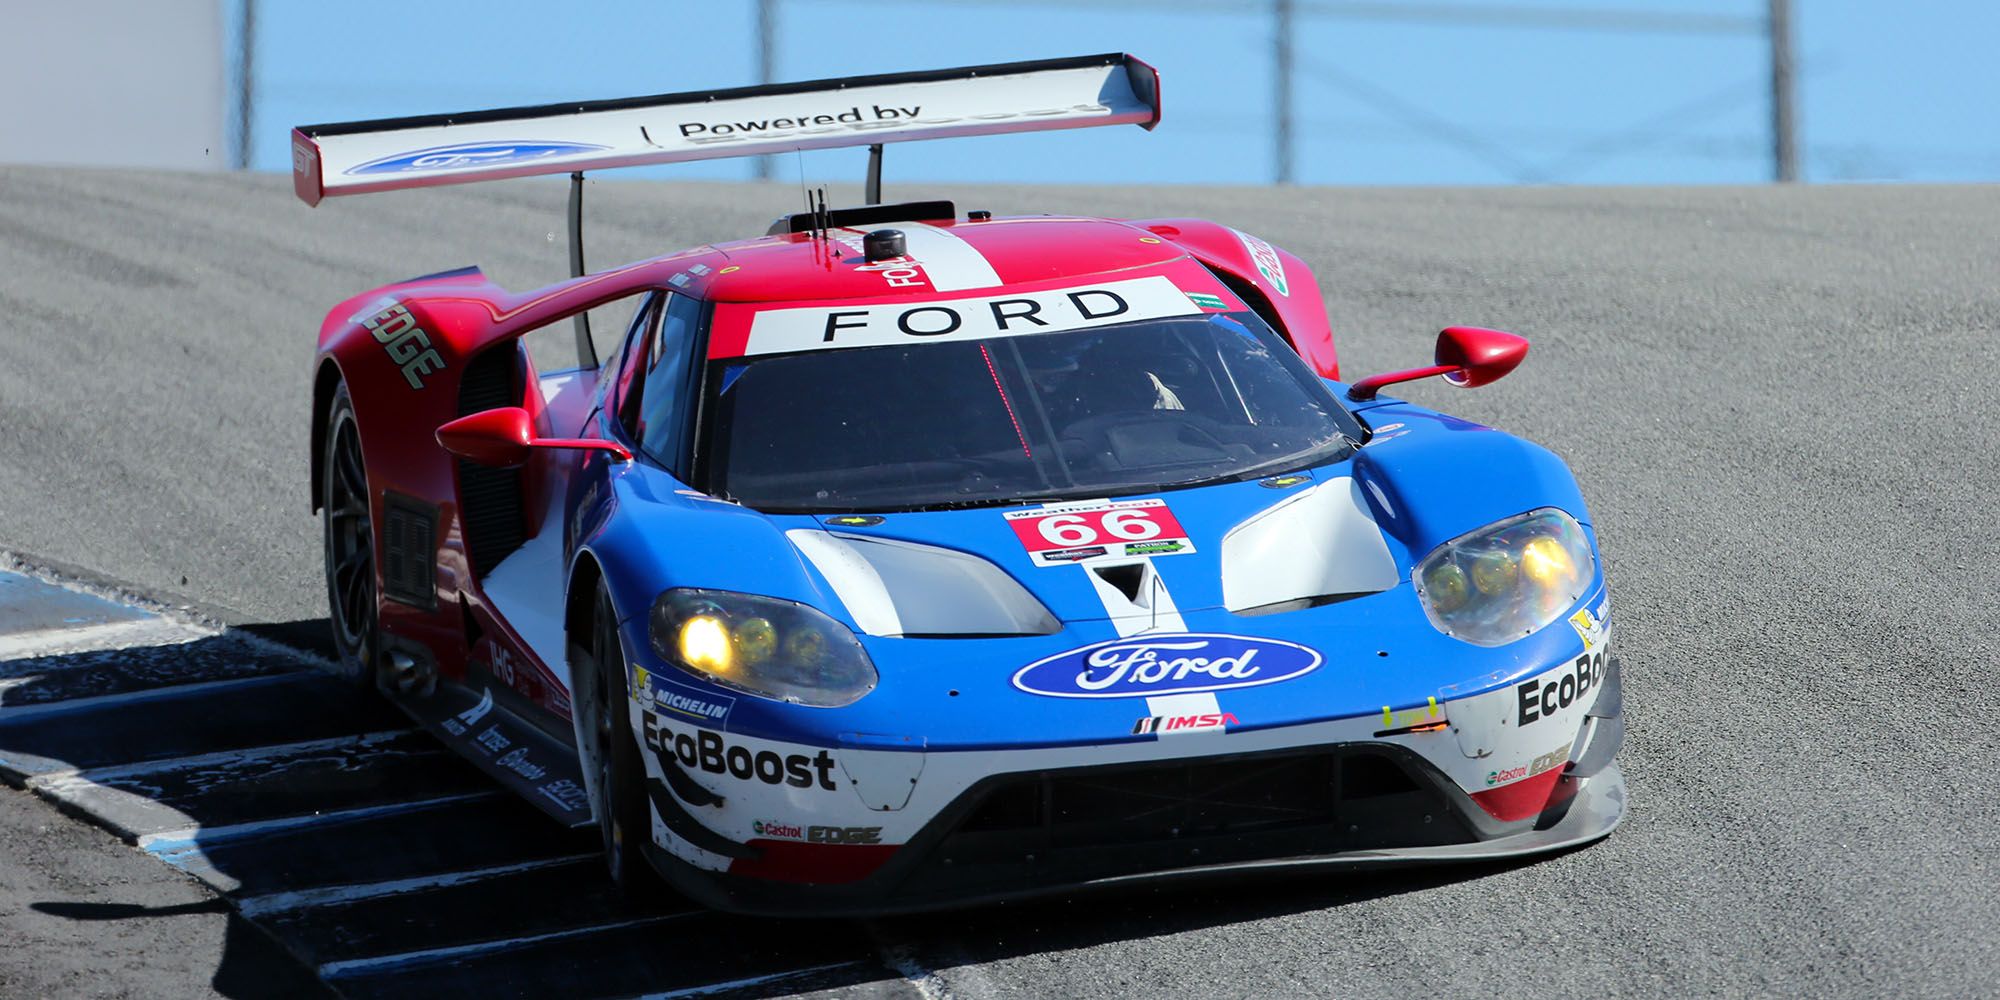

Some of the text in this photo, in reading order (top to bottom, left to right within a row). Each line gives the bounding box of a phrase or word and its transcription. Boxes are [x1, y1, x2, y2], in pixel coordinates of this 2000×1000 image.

[679, 107, 862, 137] Powered
[872, 104, 922, 121] by
[294, 142, 316, 177] GT
[823, 289, 1129, 342] FORD
[361, 303, 446, 390] EDGE
[1011, 500, 1159, 518] WeatherTech
[1037, 510, 1162, 546] 66
[489, 640, 515, 687] IHG
[1075, 641, 1261, 690] Ford
[656, 689, 729, 719] MICHELIN
[1165, 714, 1238, 731] IMSA
[642, 709, 837, 791] EcoBoost
[1496, 743, 1572, 783] Castrol EDGE
[764, 823, 884, 844] Castrol EDGE
